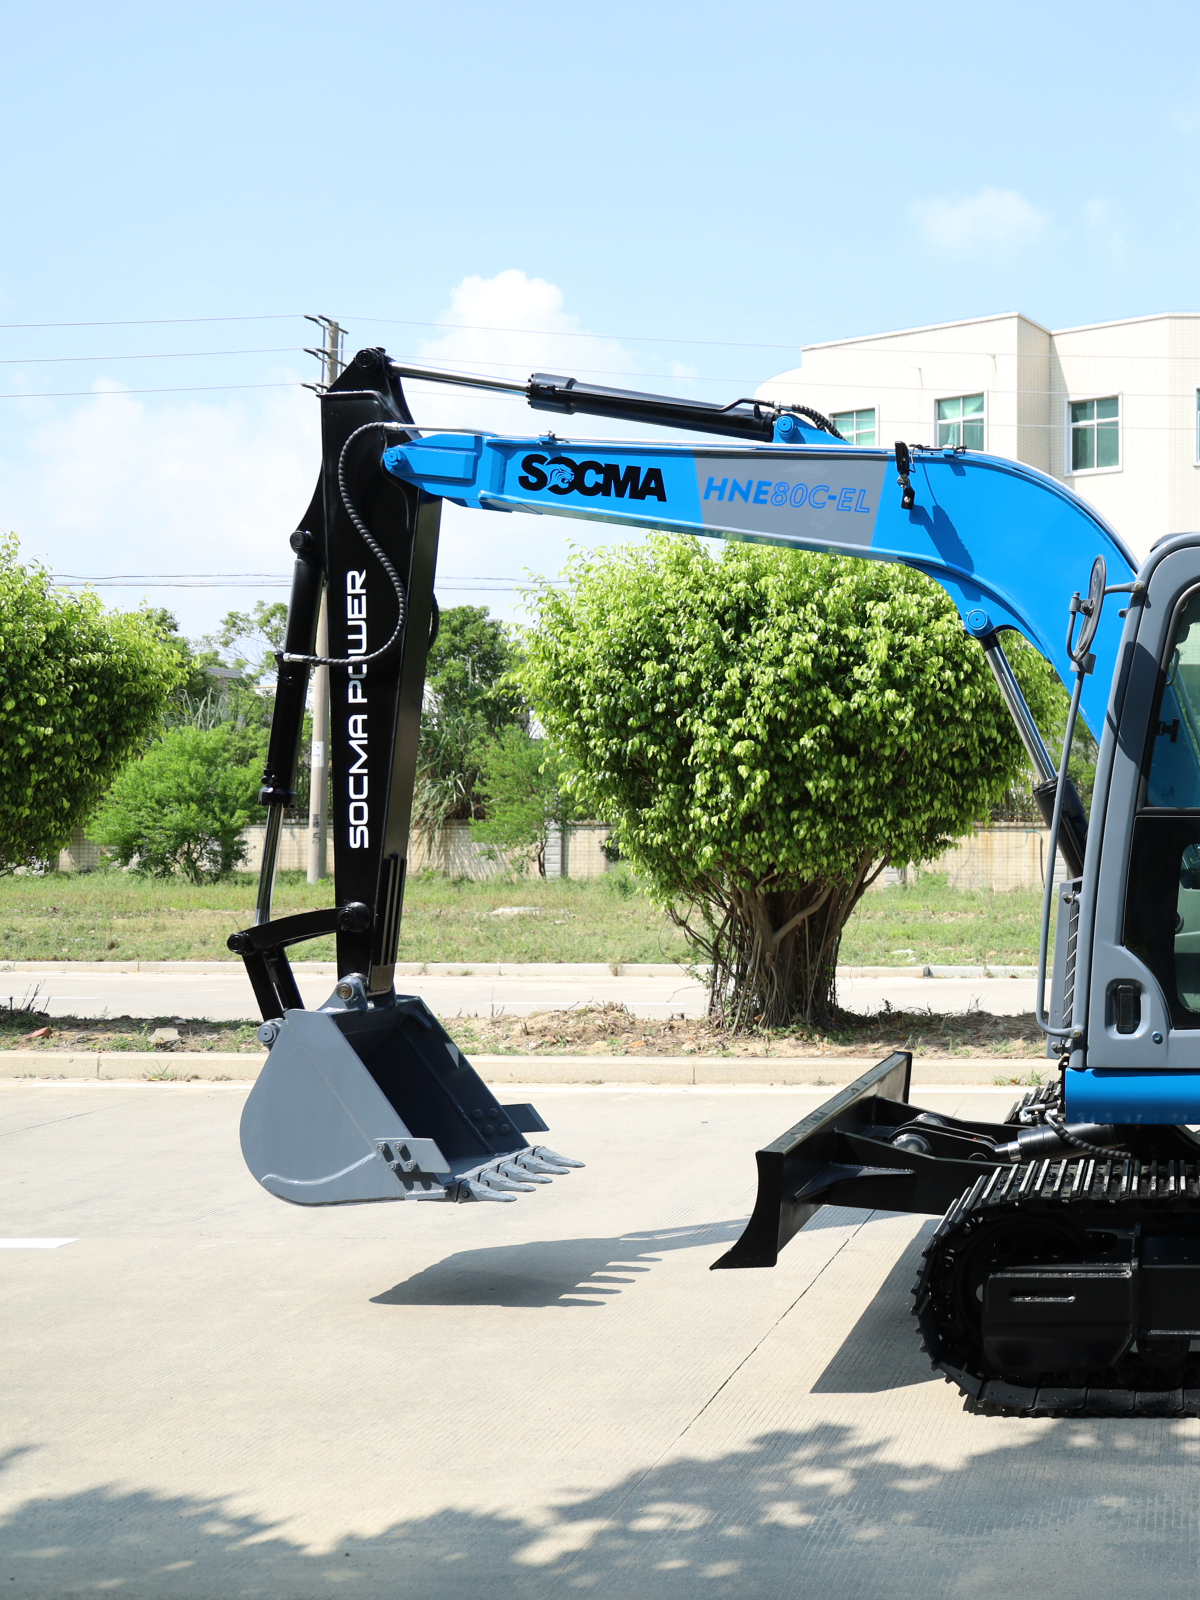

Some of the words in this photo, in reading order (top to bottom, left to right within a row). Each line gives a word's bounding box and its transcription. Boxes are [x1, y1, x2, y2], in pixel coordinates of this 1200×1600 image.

[518, 453, 668, 502] SOCMA
[703, 476, 871, 514] HNE80C-EL
[346, 569, 368, 703] POWER
[348, 714, 369, 849] SOCMA
